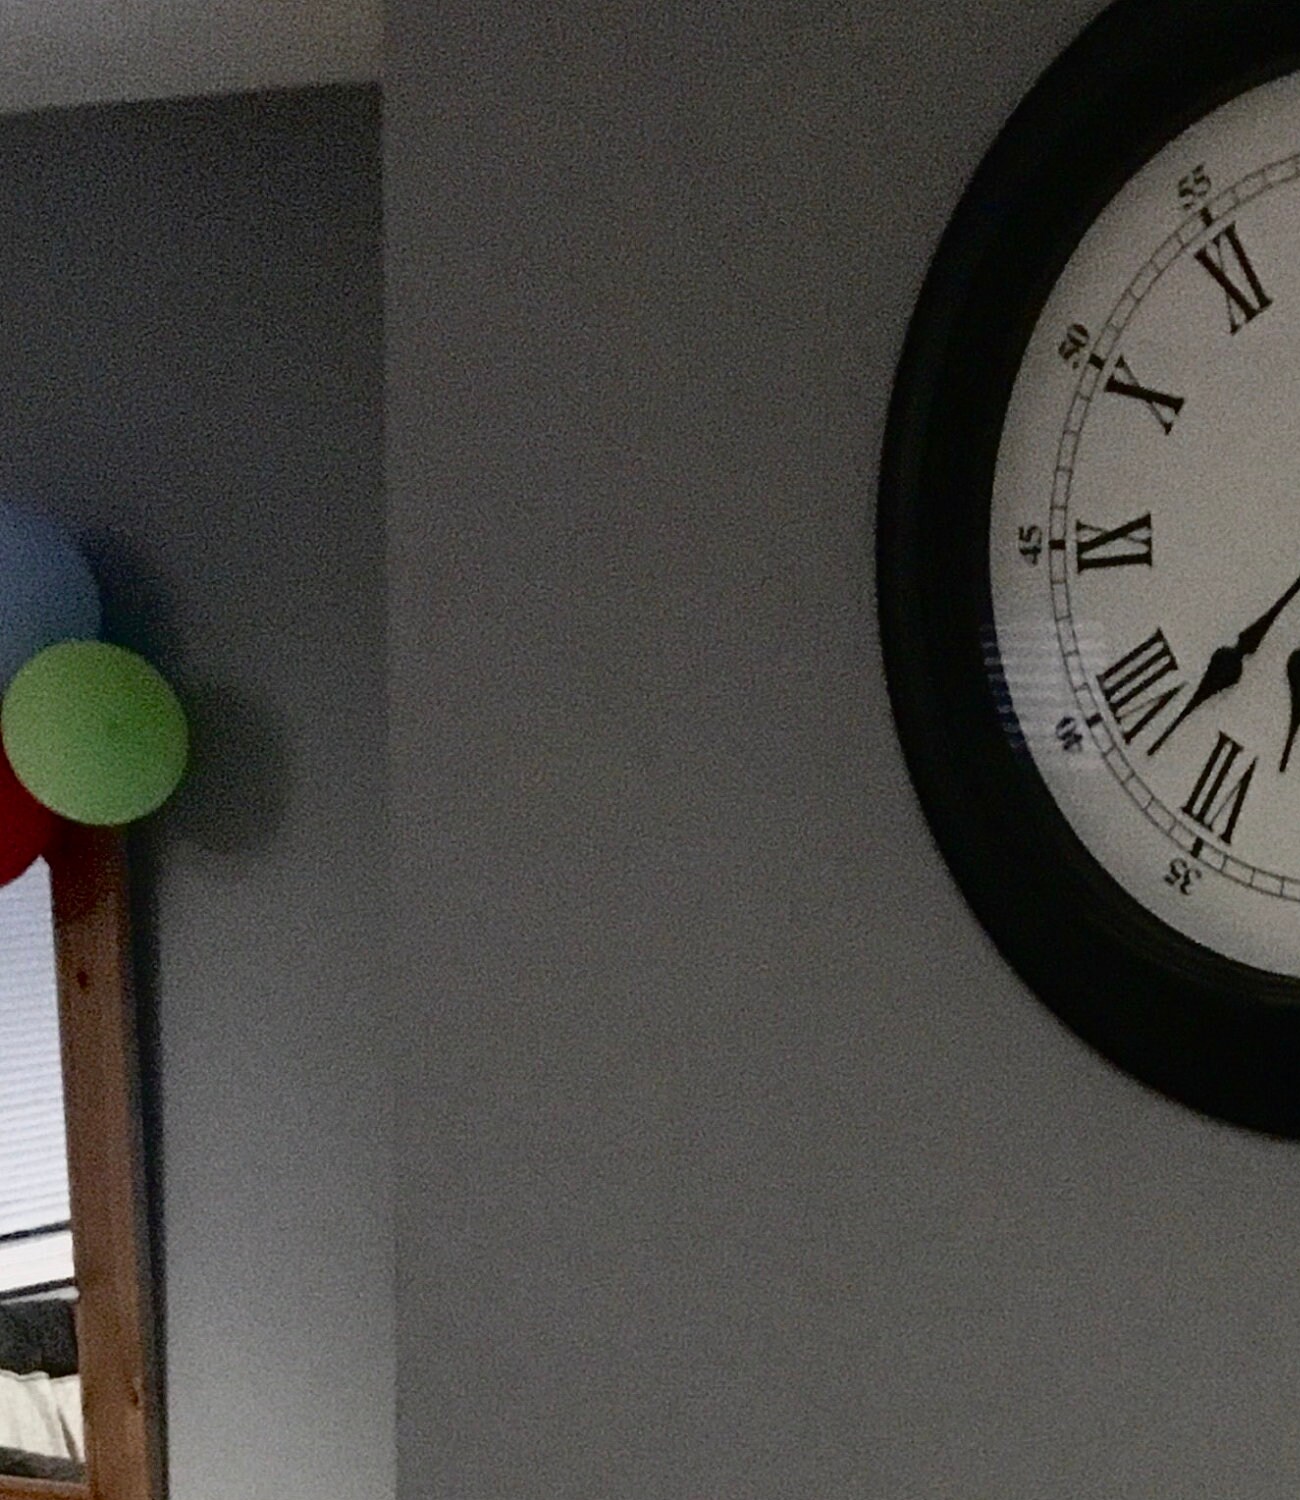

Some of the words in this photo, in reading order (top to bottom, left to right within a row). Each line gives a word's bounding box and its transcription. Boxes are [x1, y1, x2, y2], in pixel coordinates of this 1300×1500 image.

[1177, 164, 1210, 211] 55
[1194, 222, 1273, 334] XI
[1057, 323, 1091, 369] 50
[1105, 356, 1185, 435] X
[1018, 525, 1042, 565] 45
[1075, 513, 1153, 575] IX
[1096, 627, 1187, 746] VIII
[1055, 716, 1083, 753] 40
[1180, 731, 1259, 845] VII
[1164, 857, 1202, 896] 35
